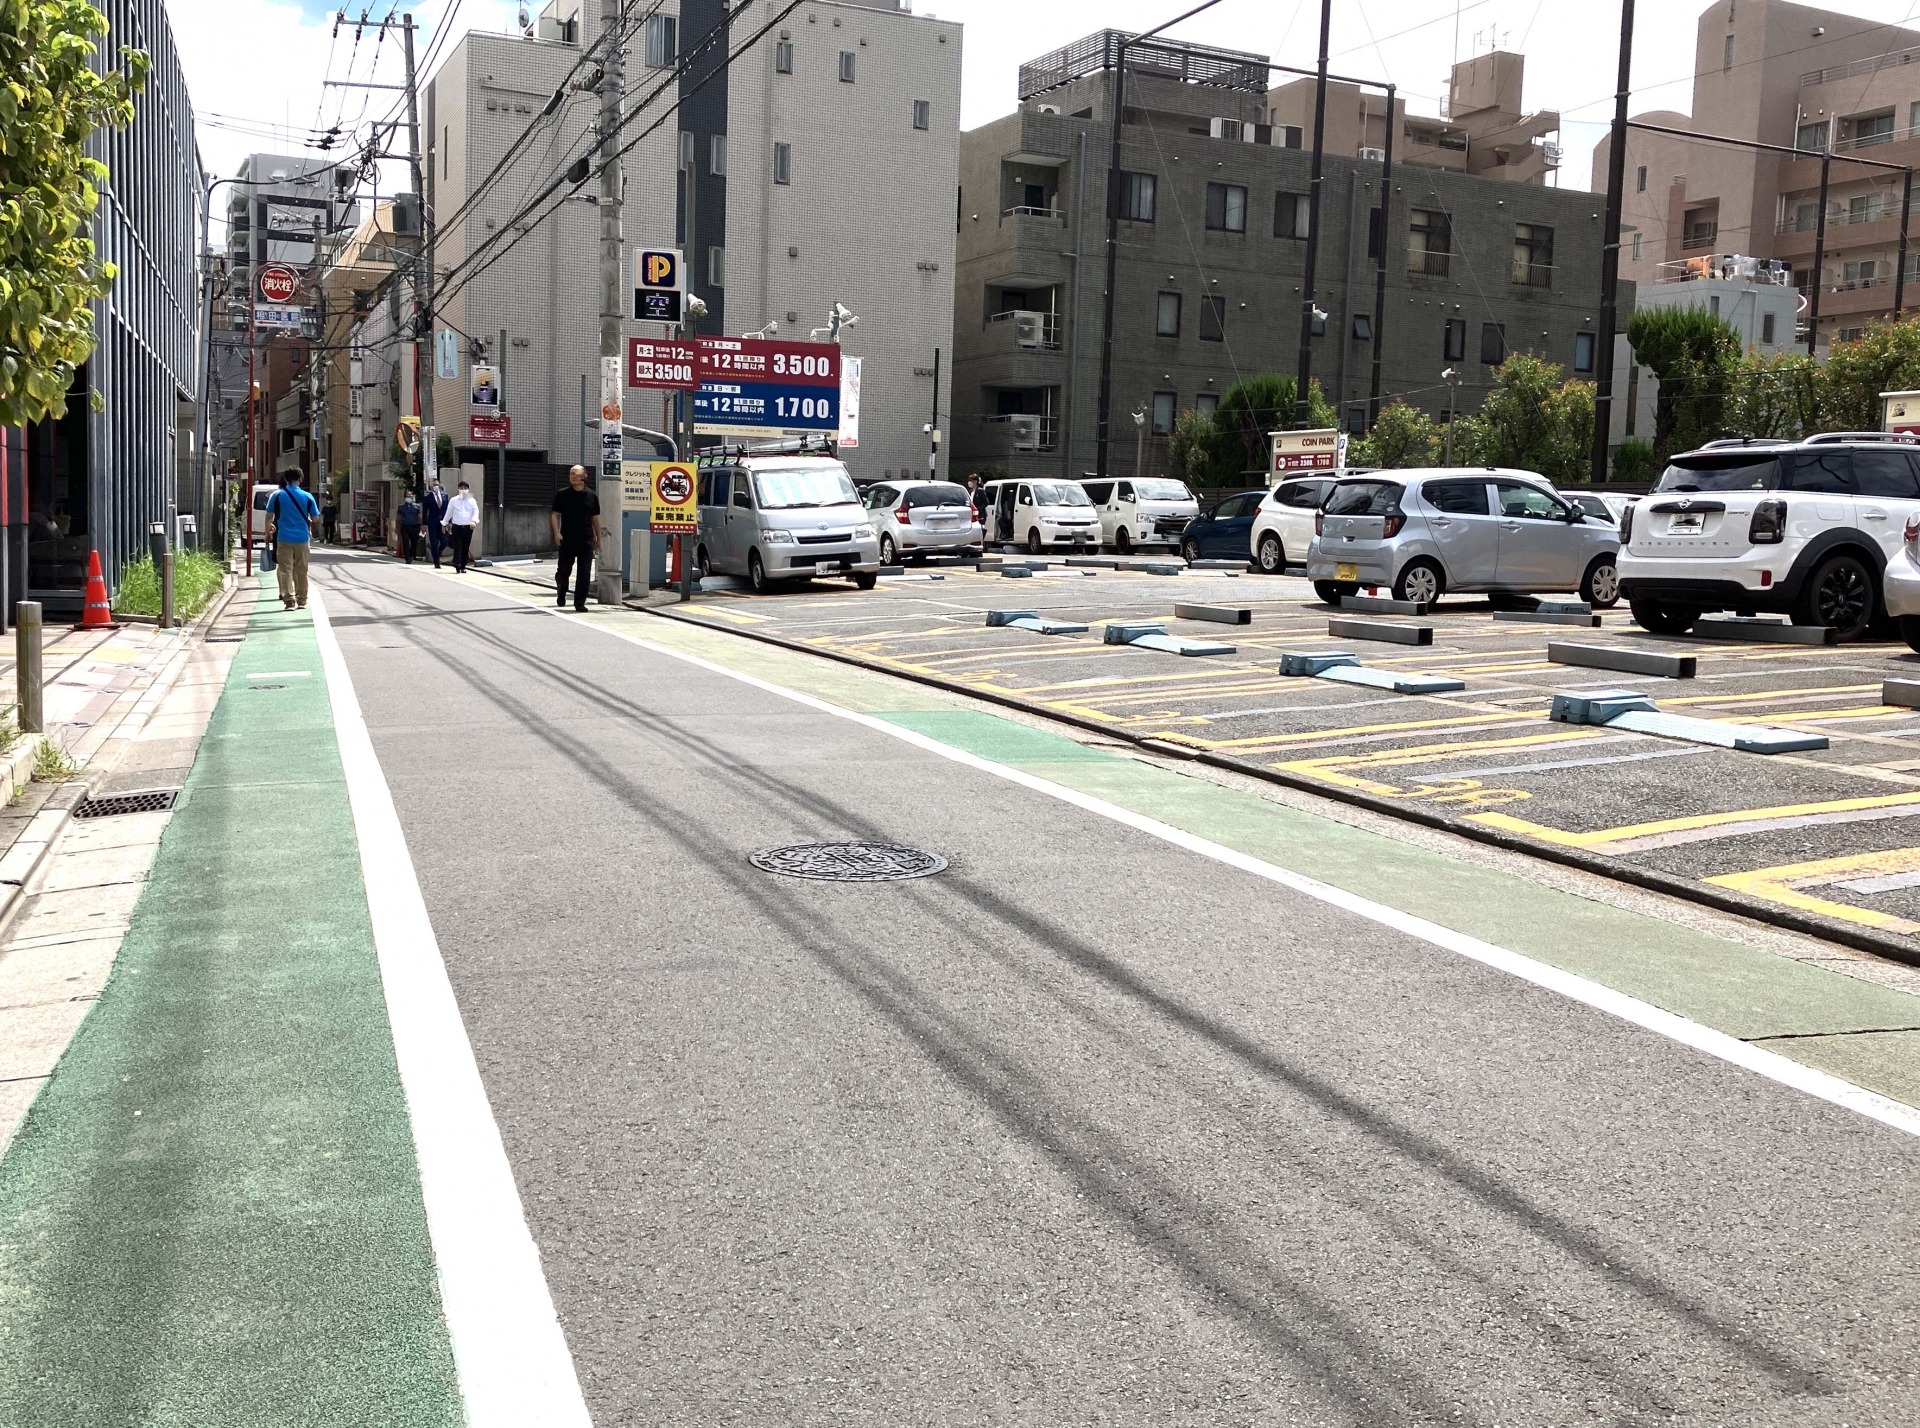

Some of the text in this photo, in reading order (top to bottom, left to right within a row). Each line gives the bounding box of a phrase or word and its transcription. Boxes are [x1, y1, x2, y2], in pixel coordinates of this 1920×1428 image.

[264, 277, 292, 292] 消火栓
[671, 346, 685, 360] 12
[712, 353, 731, 368] 12
[733, 362, 765, 371] 時間以内
[773, 353, 830, 377] 3,500
[711, 397, 731, 412] 12
[733, 405, 765, 414] 時間以内
[774, 396, 830, 419] 1,700
[1302, 437, 1335, 447] COIN PARK
[655, 512, 695, 522] 販売禁止
